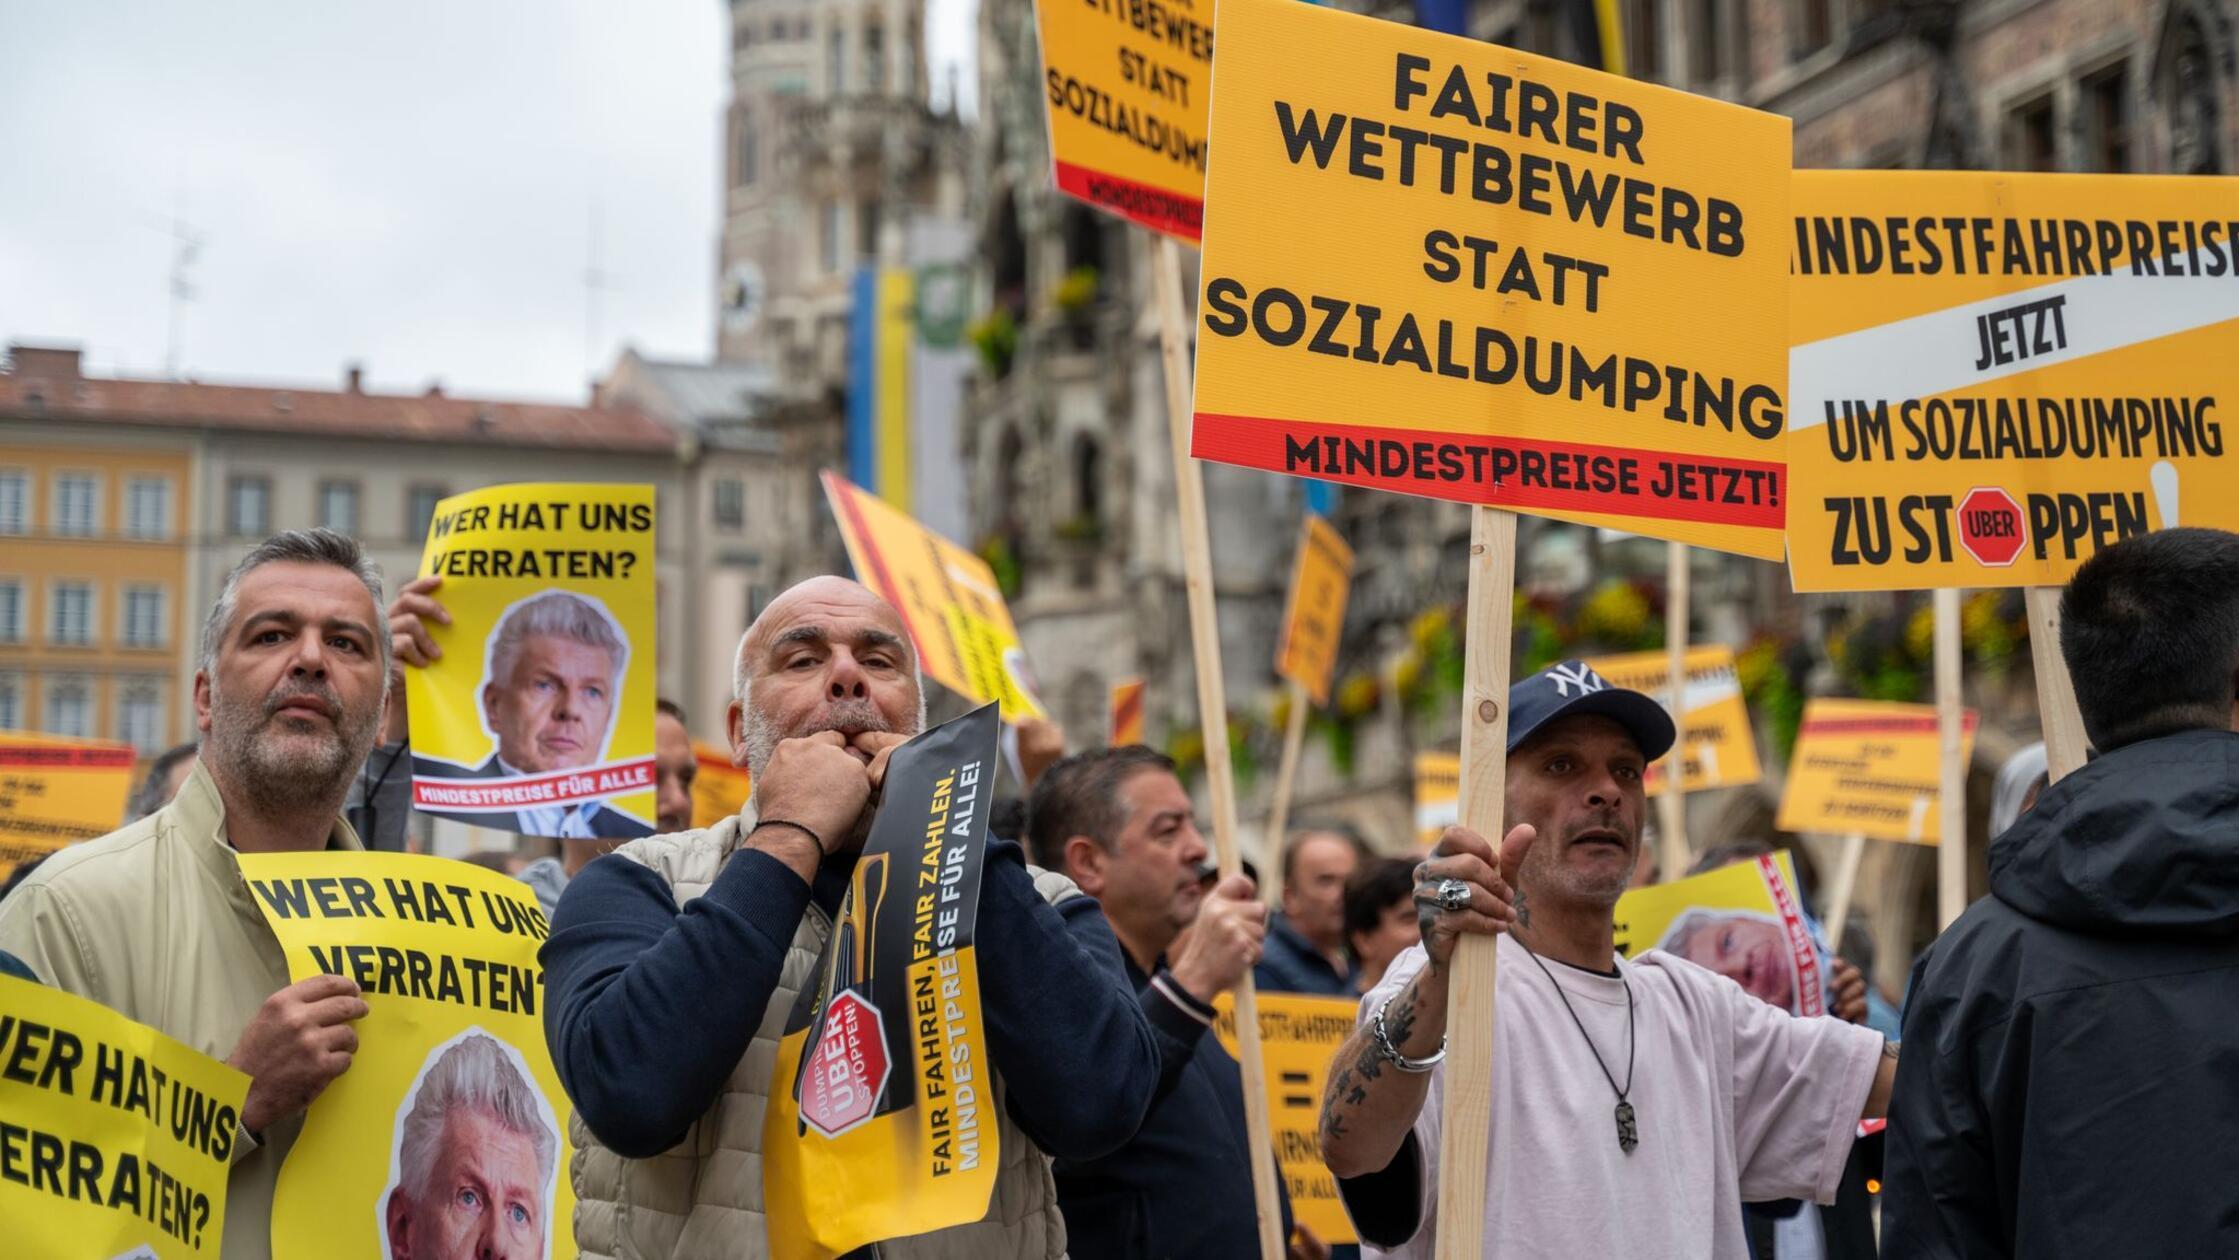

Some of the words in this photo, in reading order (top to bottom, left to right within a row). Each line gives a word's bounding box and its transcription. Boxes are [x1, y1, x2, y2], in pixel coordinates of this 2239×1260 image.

[1119, 46, 1190, 107] STATT
[1394, 52, 1645, 165] FAIRER
[1047, 66, 1208, 174] SOZIALDUM
[1274, 100, 1745, 257] WETTBEWERB
[1422, 230, 1610, 313] STATT
[1790, 216, 2239, 277] INDESTFAHRPREIS
[1205, 278, 1784, 440] SOZIALDUMPING
[1976, 294, 2067, 371] JETZT
[1824, 400, 1895, 462] UM
[1901, 397, 2224, 460] SOZIALDUMPING
[1285, 434, 1640, 496] MINDESTPREISE
[1650, 461, 1779, 507] JETZT!
[434, 506, 490, 539] WER
[499, 504, 569, 530] HAT
[579, 504, 651, 531] UNS
[1824, 497, 1891, 566] ZU
[1966, 511, 2016, 538] UBER
[433, 550, 636, 578] VERRATEN?
[419, 784, 554, 804] MINDESTPREISE
[558, 773, 593, 797] FÜR
[600, 767, 648, 790] ALLE
[951, 761, 981, 837] ALLE!
[919, 768, 956, 888] ZAHLEN.
[251, 877, 385, 919] WER
[383, 878, 476, 928] HAT
[480, 890, 549, 941] UNS
[939, 844, 968, 904] FÜR
[914, 893, 936, 960] FAIR
[308, 946, 545, 1016] VERRATEN
[825, 1009, 854, 1114] UBER
[844, 1001, 871, 1101] STOPPEN!
[915, 965, 947, 1100] FAHREN,
[937, 906, 979, 1172] MINDESTPREISE
[0, 1015, 83, 1096] ER
[90, 1042, 166, 1128] HAT
[171, 1080, 237, 1163] UNS
[931, 1106, 951, 1178] FAIR
